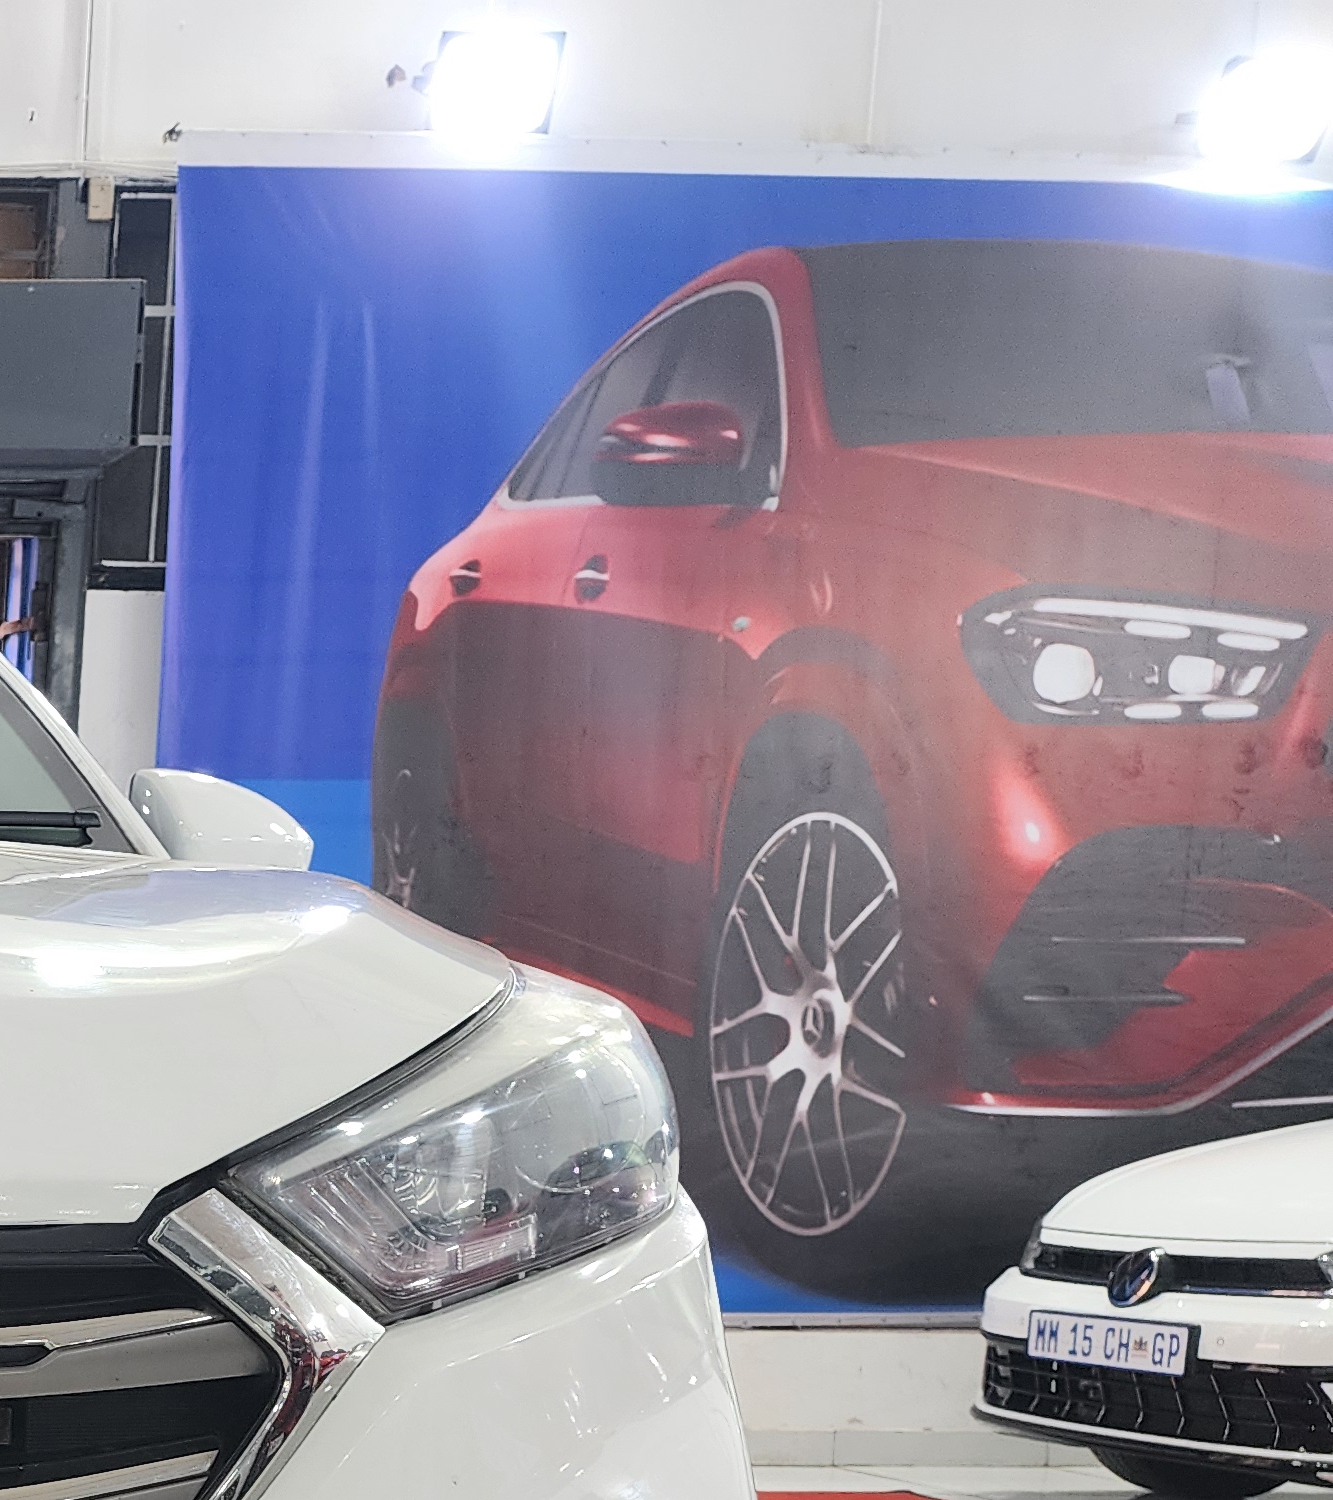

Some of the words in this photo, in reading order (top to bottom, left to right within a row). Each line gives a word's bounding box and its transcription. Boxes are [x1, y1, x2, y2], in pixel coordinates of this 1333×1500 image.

[1068, 1322, 1094, 1357] 15
[1104, 1327, 1132, 1362] CH
[1151, 1332, 1181, 1368] GP
